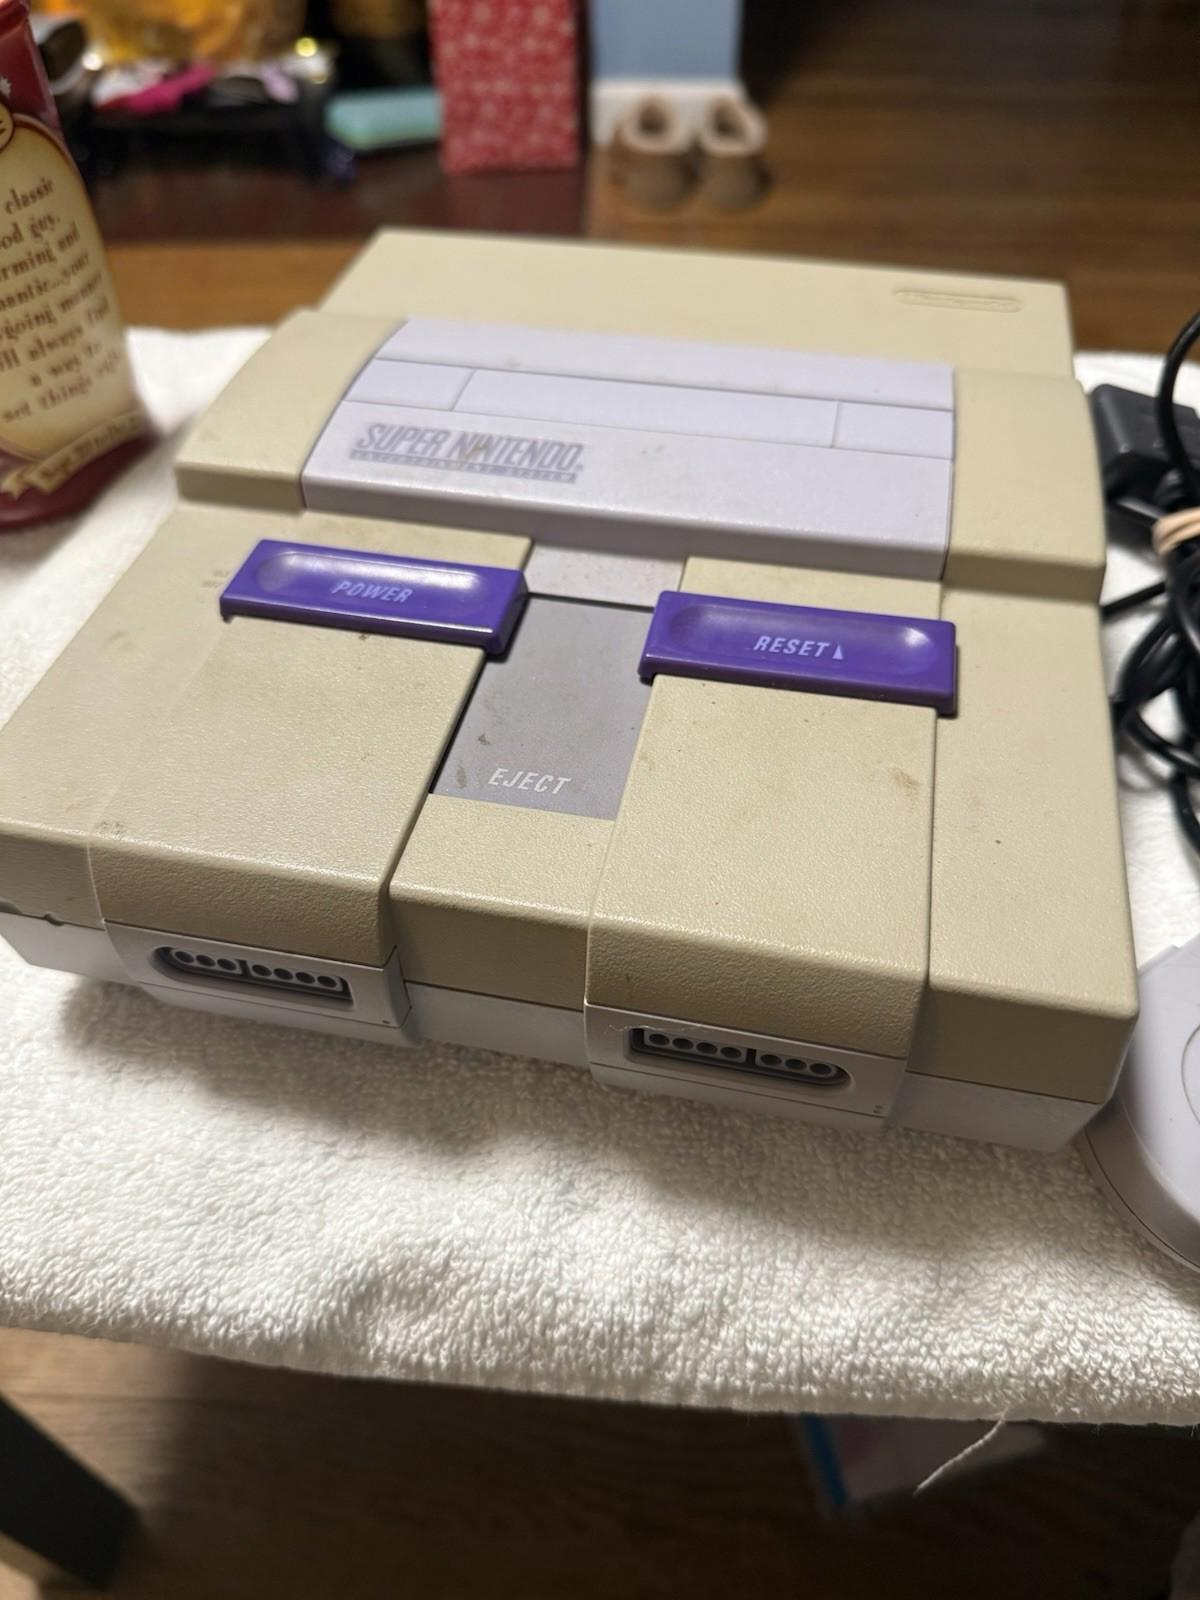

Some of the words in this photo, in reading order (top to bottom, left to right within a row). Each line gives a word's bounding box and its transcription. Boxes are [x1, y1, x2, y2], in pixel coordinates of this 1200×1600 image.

[5, 176, 55, 214] classic
[0, 221, 25, 250] od
[0, 245, 58, 282] rming
[0, 303, 58, 343] going
[357, 422, 451, 458] SUPER
[452, 430, 585, 472] NINTENDO
[331, 580, 414, 603] POWER
[753, 635, 830, 657] RESET
[487, 767, 572, 795] EJECT
